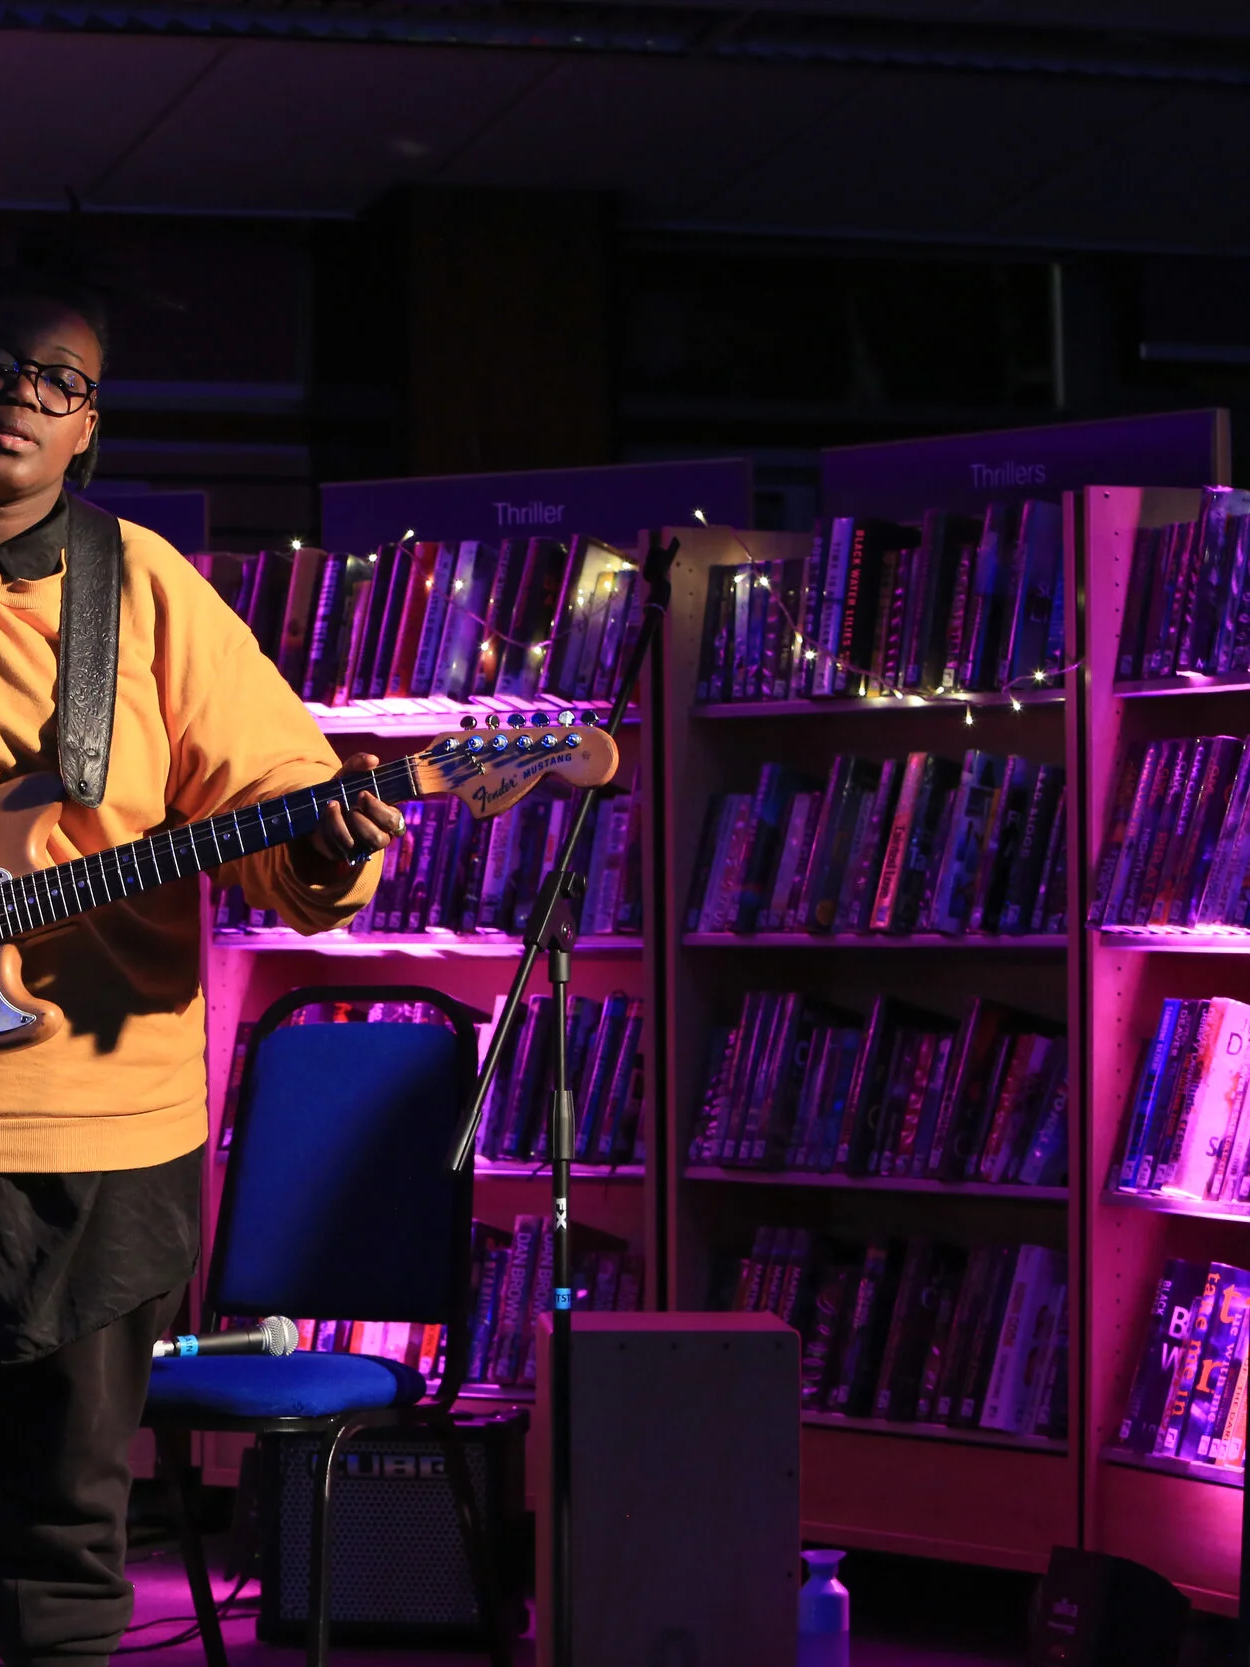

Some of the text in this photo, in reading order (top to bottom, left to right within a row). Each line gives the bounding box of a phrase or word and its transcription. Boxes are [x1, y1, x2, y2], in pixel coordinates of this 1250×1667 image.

[970, 459, 1047, 489] Thrillers
[491, 501, 566, 527] Thriller
[851, 528, 866, 561] BLACK
[847, 567, 862, 607] WATER
[523, 753, 573, 779] MUSTANG
[472, 777, 518, 813] Fender
[1171, 1009, 1189, 1057] DEAVER
[503, 1232, 532, 1326] DAN BROWN
[1156, 1279, 1173, 1317] BLACK
[1195, 1272, 1221, 1329] take
[1182, 1340, 1203, 1381] me
[1216, 1343, 1235, 1387] with
[1171, 1390, 1189, 1417] in
[1207, 1393, 1222, 1422] me
[1233, 1386, 1243, 1405] THE
[311, 1453, 449, 1479] UBE
